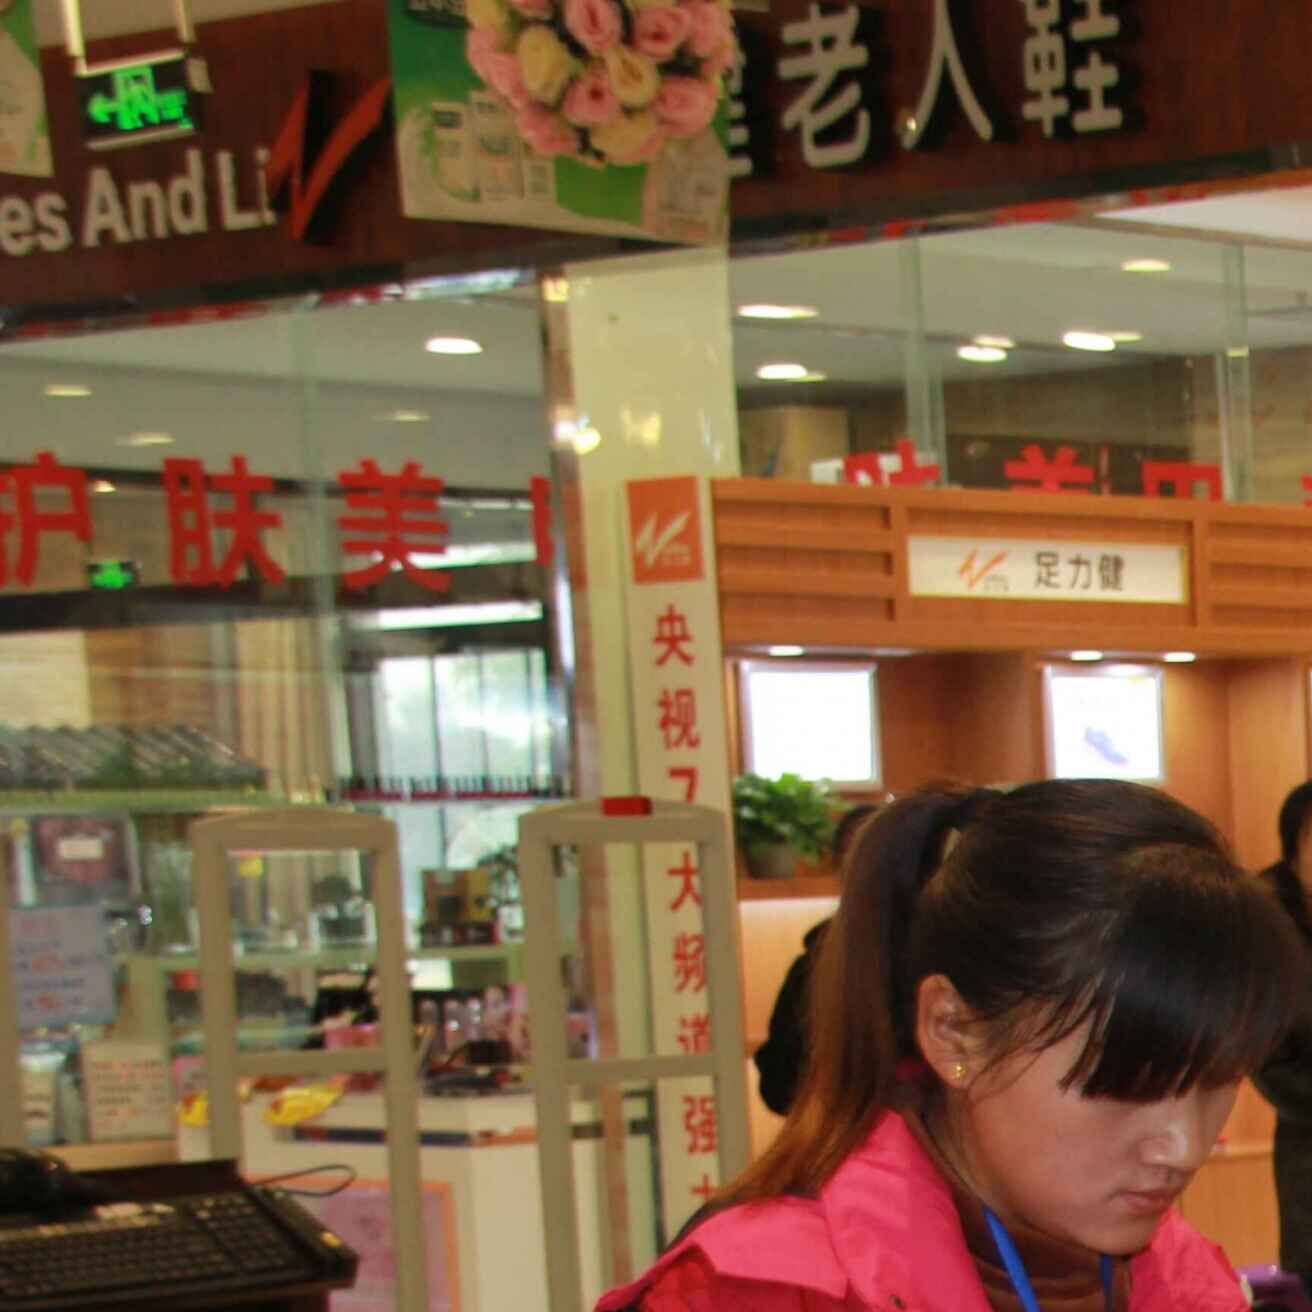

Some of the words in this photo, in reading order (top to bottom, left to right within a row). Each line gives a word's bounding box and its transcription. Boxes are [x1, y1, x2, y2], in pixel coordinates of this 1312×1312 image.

[729, 0, 1122, 177] 老人鞋
[82, 147, 208, 247] And
[0, 451, 556, 592] 护肤美
[1034, 550, 1125, 592] 足力健
